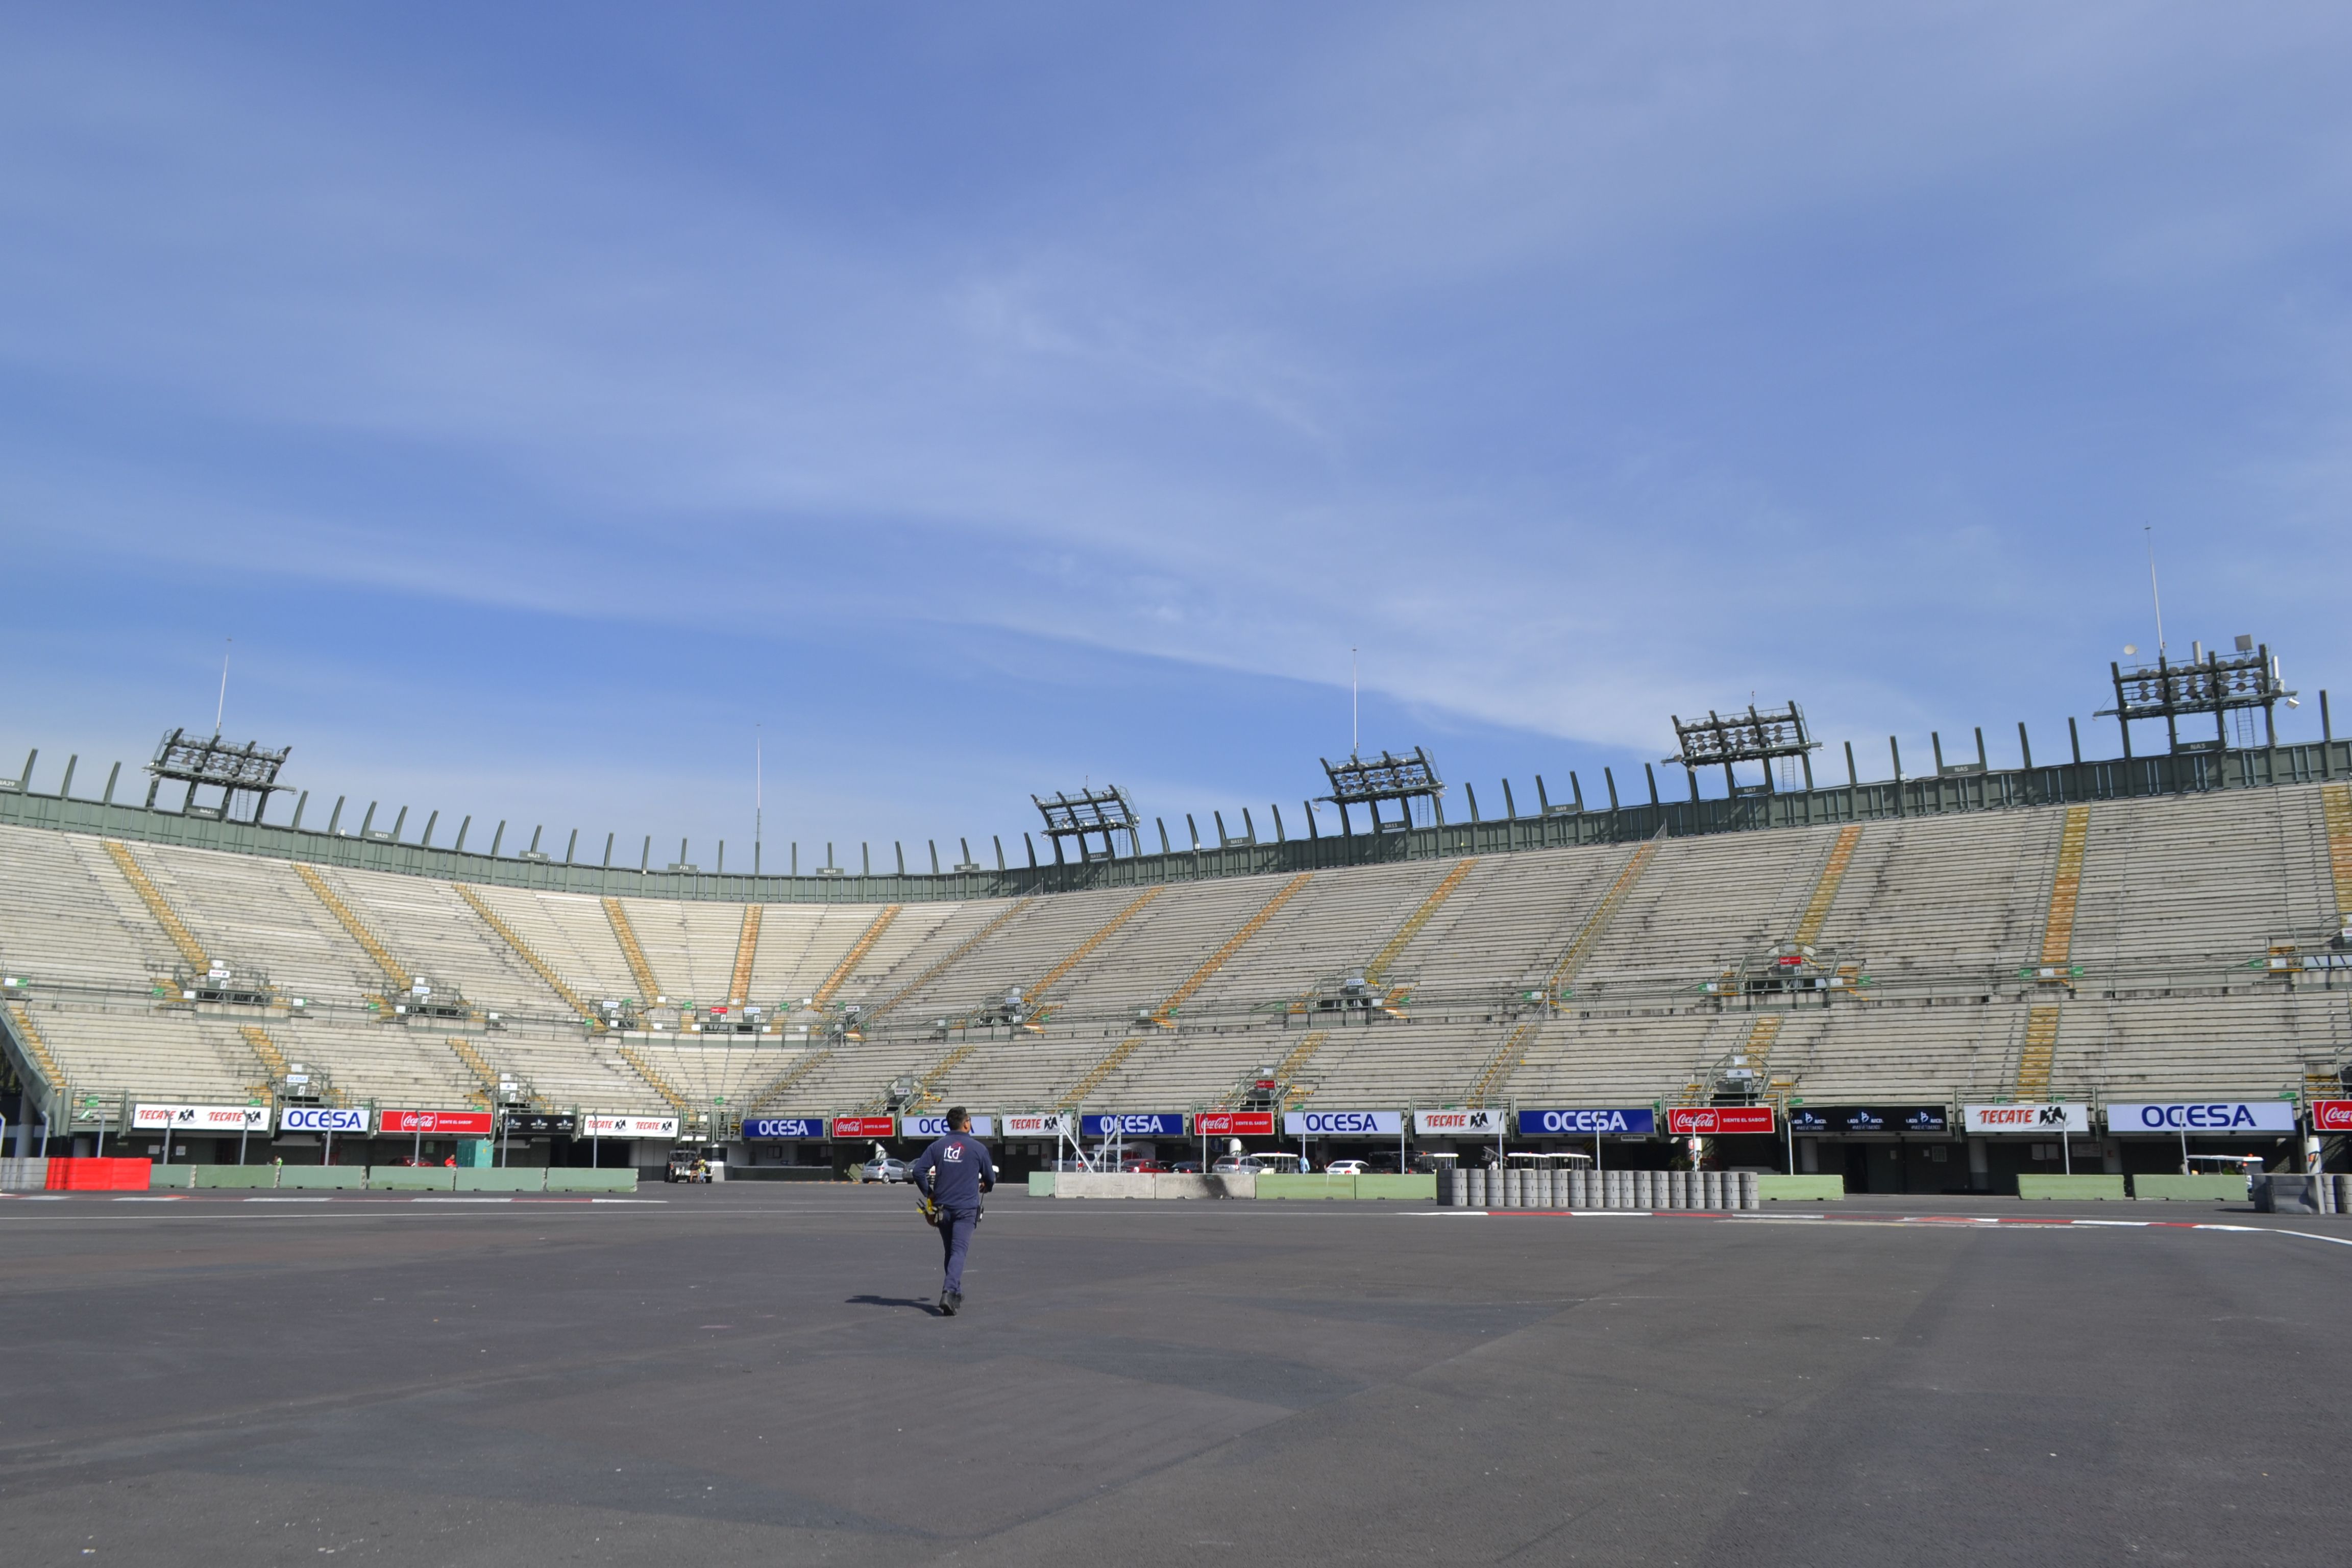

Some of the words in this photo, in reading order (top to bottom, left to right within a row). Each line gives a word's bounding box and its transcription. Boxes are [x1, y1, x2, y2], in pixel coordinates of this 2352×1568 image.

[208, 1112, 244, 1122] TECATE
[288, 1111, 361, 1129] OCESA
[588, 1120, 614, 1129] TECATE
[1010, 1119, 1042, 1130] TECATE
[1100, 1115, 1164, 1133] OCESA
[1306, 1114, 1378, 1131] OCESA
[1425, 1115, 1466, 1128] TECATE
[1543, 1111, 1628, 1131] OCESA
[1977, 1110, 2035, 1125] TECATE
[2141, 1105, 2257, 1128] OCESA
[635, 1121, 660, 1130] TECATE
[758, 1120, 808, 1136] OCESA
[919, 1118, 974, 1134] OCE
